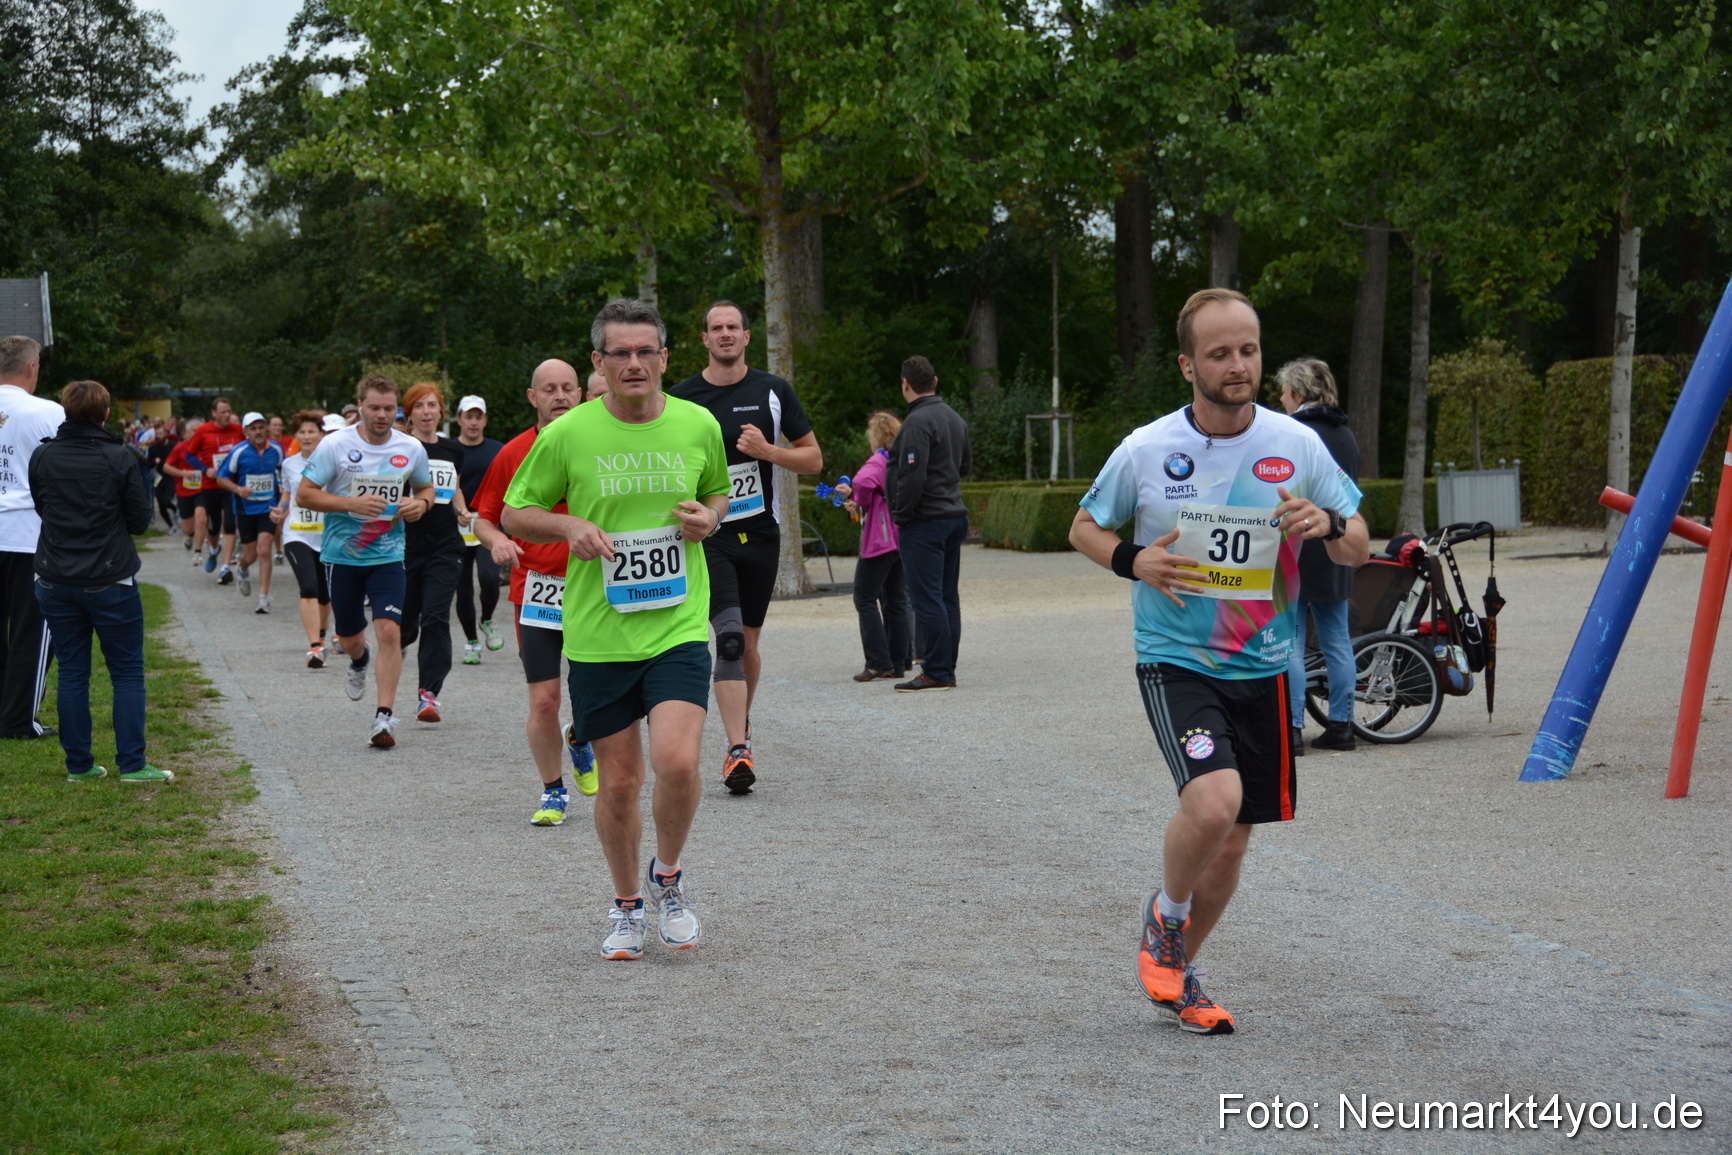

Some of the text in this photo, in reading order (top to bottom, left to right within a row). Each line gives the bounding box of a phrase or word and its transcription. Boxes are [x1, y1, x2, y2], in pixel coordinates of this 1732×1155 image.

[0, 445, 14, 455] AG
[595, 452, 686, 473] NOVINA
[1258, 463, 1290, 476] Hervis
[600, 475, 687, 496] HOTELS
[728, 475, 758, 499] 22
[1165, 485, 1198, 494] PARTL
[357, 485, 399, 503] 2769
[299, 510, 319, 522] 197
[1181, 511, 1266, 526] PARTL Neumarkt
[632, 535, 673, 547] Neumarkt
[1208, 528, 1250, 564] 30
[612, 545, 680, 581] 2580
[528, 571, 549, 580] PARTL
[1208, 571, 1242, 587] Maze
[627, 586, 672, 600] Thomas
[1261, 628, 1276, 645] 16.
